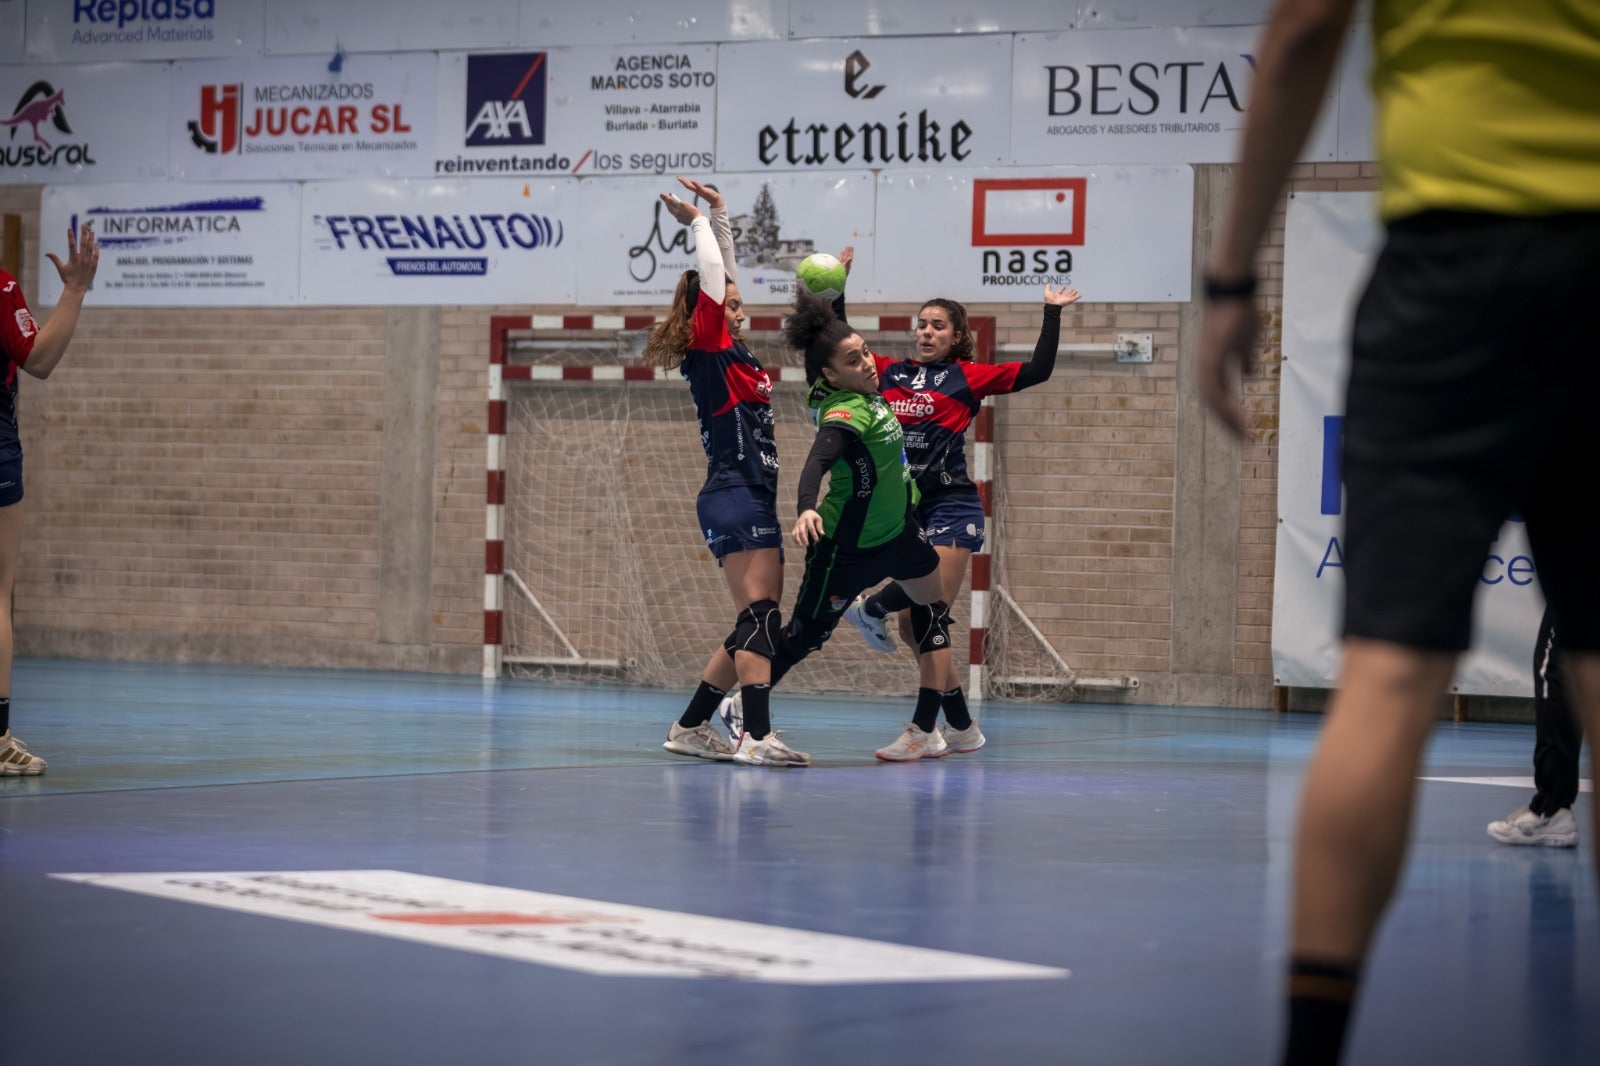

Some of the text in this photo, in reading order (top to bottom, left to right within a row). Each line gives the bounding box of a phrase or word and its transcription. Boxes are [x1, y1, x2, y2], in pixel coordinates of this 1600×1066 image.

[73, 0, 215, 28] Replasa
[72, 25, 214, 44] Advanced Materials
[616, 55, 691, 71] AGENCIA
[591, 72, 715, 90] MARCOS SOTO
[1043, 54, 1256, 116] BESTA
[255, 82, 374, 101] MECANIZADOS
[605, 104, 641, 115] Villava
[650, 103, 701, 114] Atarrabia
[245, 103, 412, 137] JUCAR SL
[465, 100, 533, 139] AXA
[606, 121, 648, 131] Burlada
[1047, 122, 1221, 135] ABOGADOS Y ASESORES TRIBUTARIOS
[759, 109, 973, 165] etxenike
[246, 143, 296, 153] Soluciones
[342, 142, 353, 150] en
[356, 140, 418, 150] Mecanizados
[435, 150, 713, 174] reinventando los seguros
[103, 216, 241, 233] INFORMATICA
[326, 213, 541, 249] FRENAUTO
[217, 255, 254, 265] SISTEMAS
[427, 260, 440, 271] DEL
[983, 249, 1072, 274] nasa
[983, 275, 1071, 285] PRODUCCIONES
[911, 366, 927, 390] 4
[889, 400, 935, 417] atticgo
